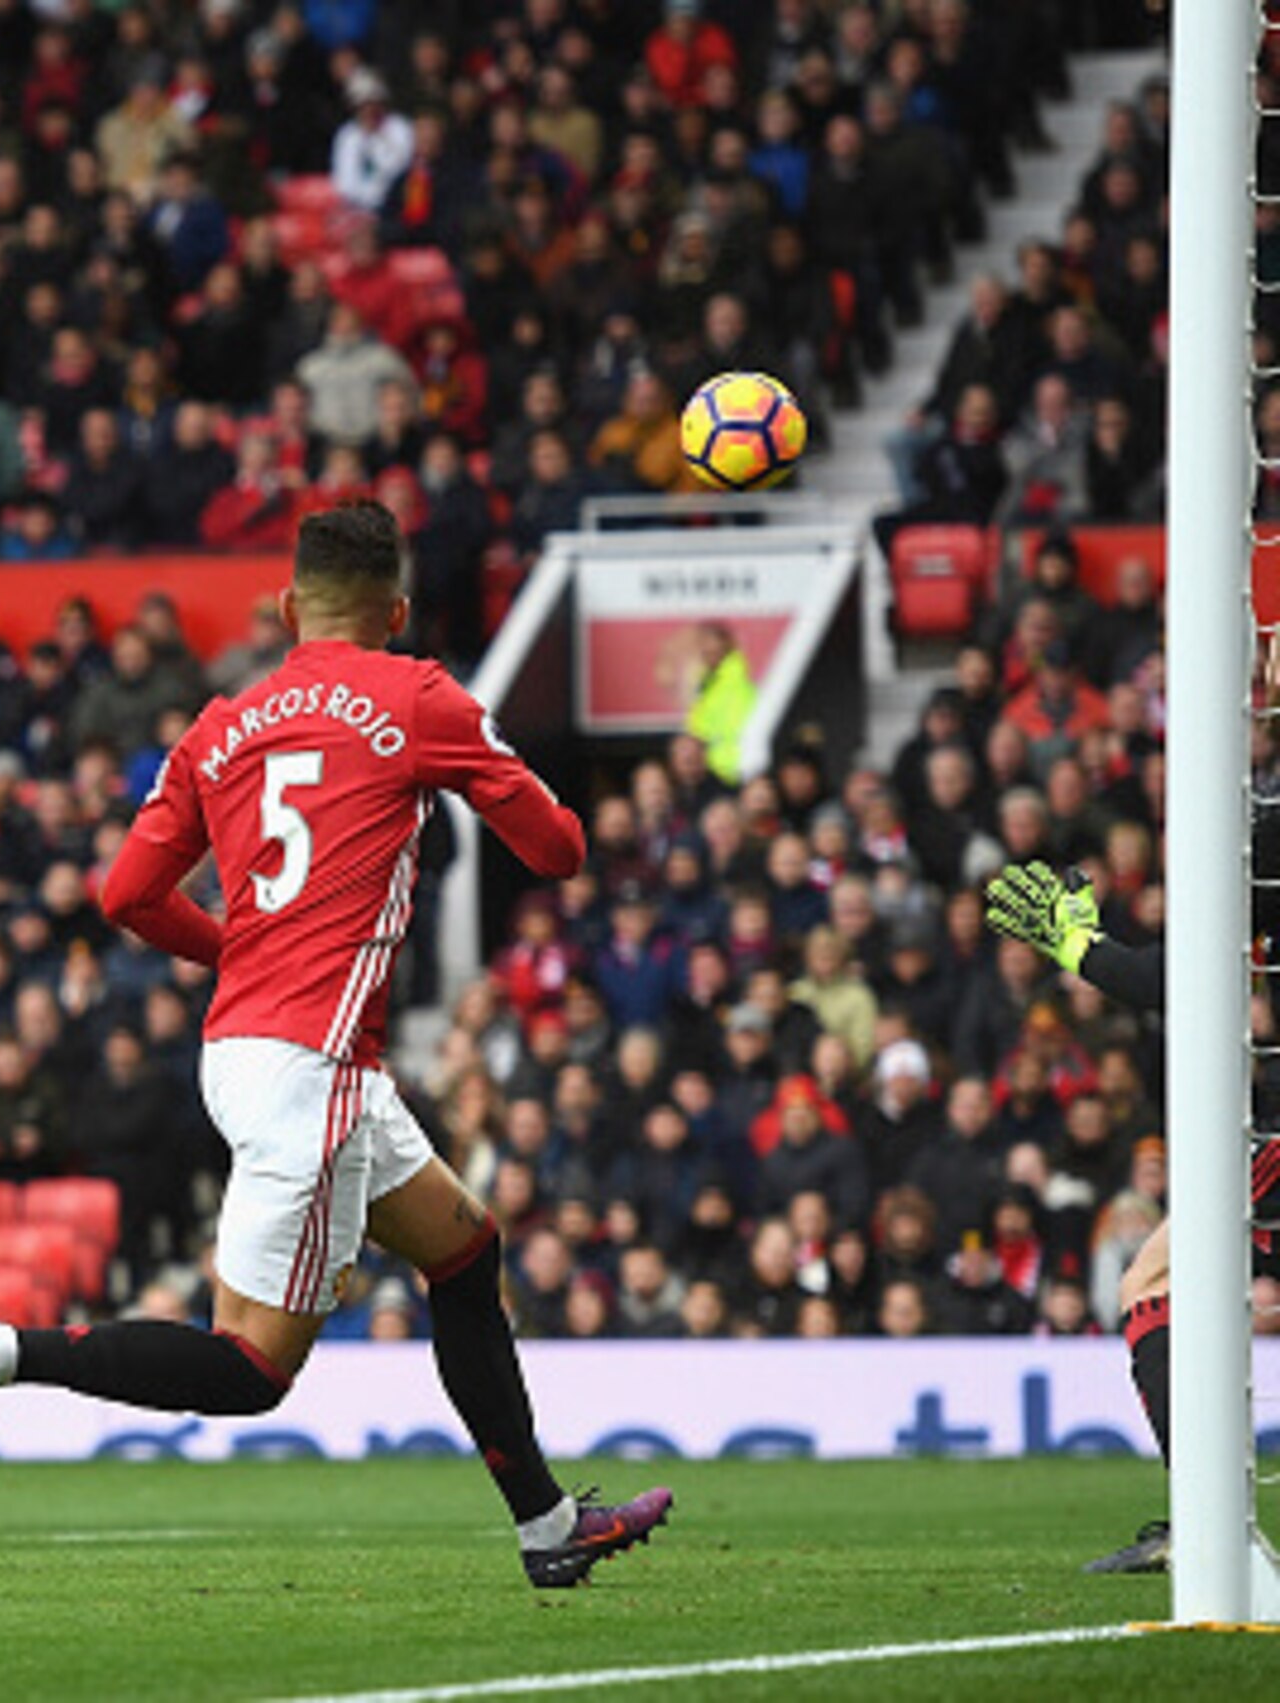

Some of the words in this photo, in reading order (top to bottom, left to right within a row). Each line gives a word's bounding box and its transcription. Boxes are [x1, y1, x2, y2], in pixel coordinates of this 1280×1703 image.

[199, 682, 326, 783] MARCOS
[323, 682, 407, 758] ROJO
[248, 749, 324, 914] 5
